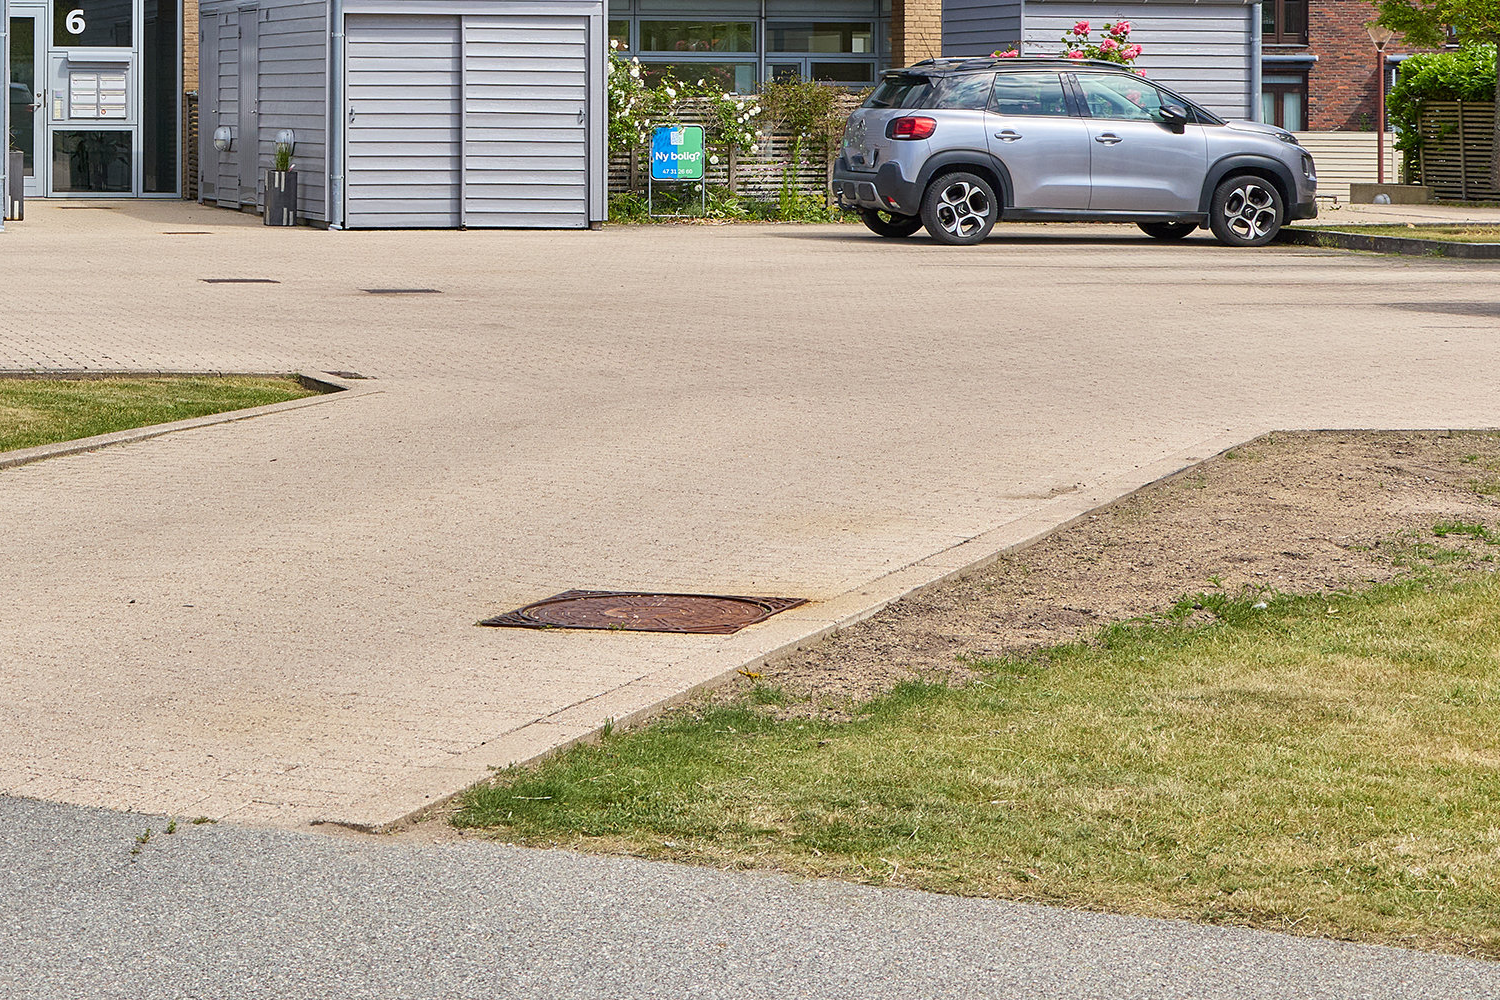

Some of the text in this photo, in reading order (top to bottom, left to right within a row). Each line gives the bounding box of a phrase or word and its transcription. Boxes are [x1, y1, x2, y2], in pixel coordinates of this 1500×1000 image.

[65, 9, 86, 34] 6
[655, 152, 700, 162] Ny bolig?
